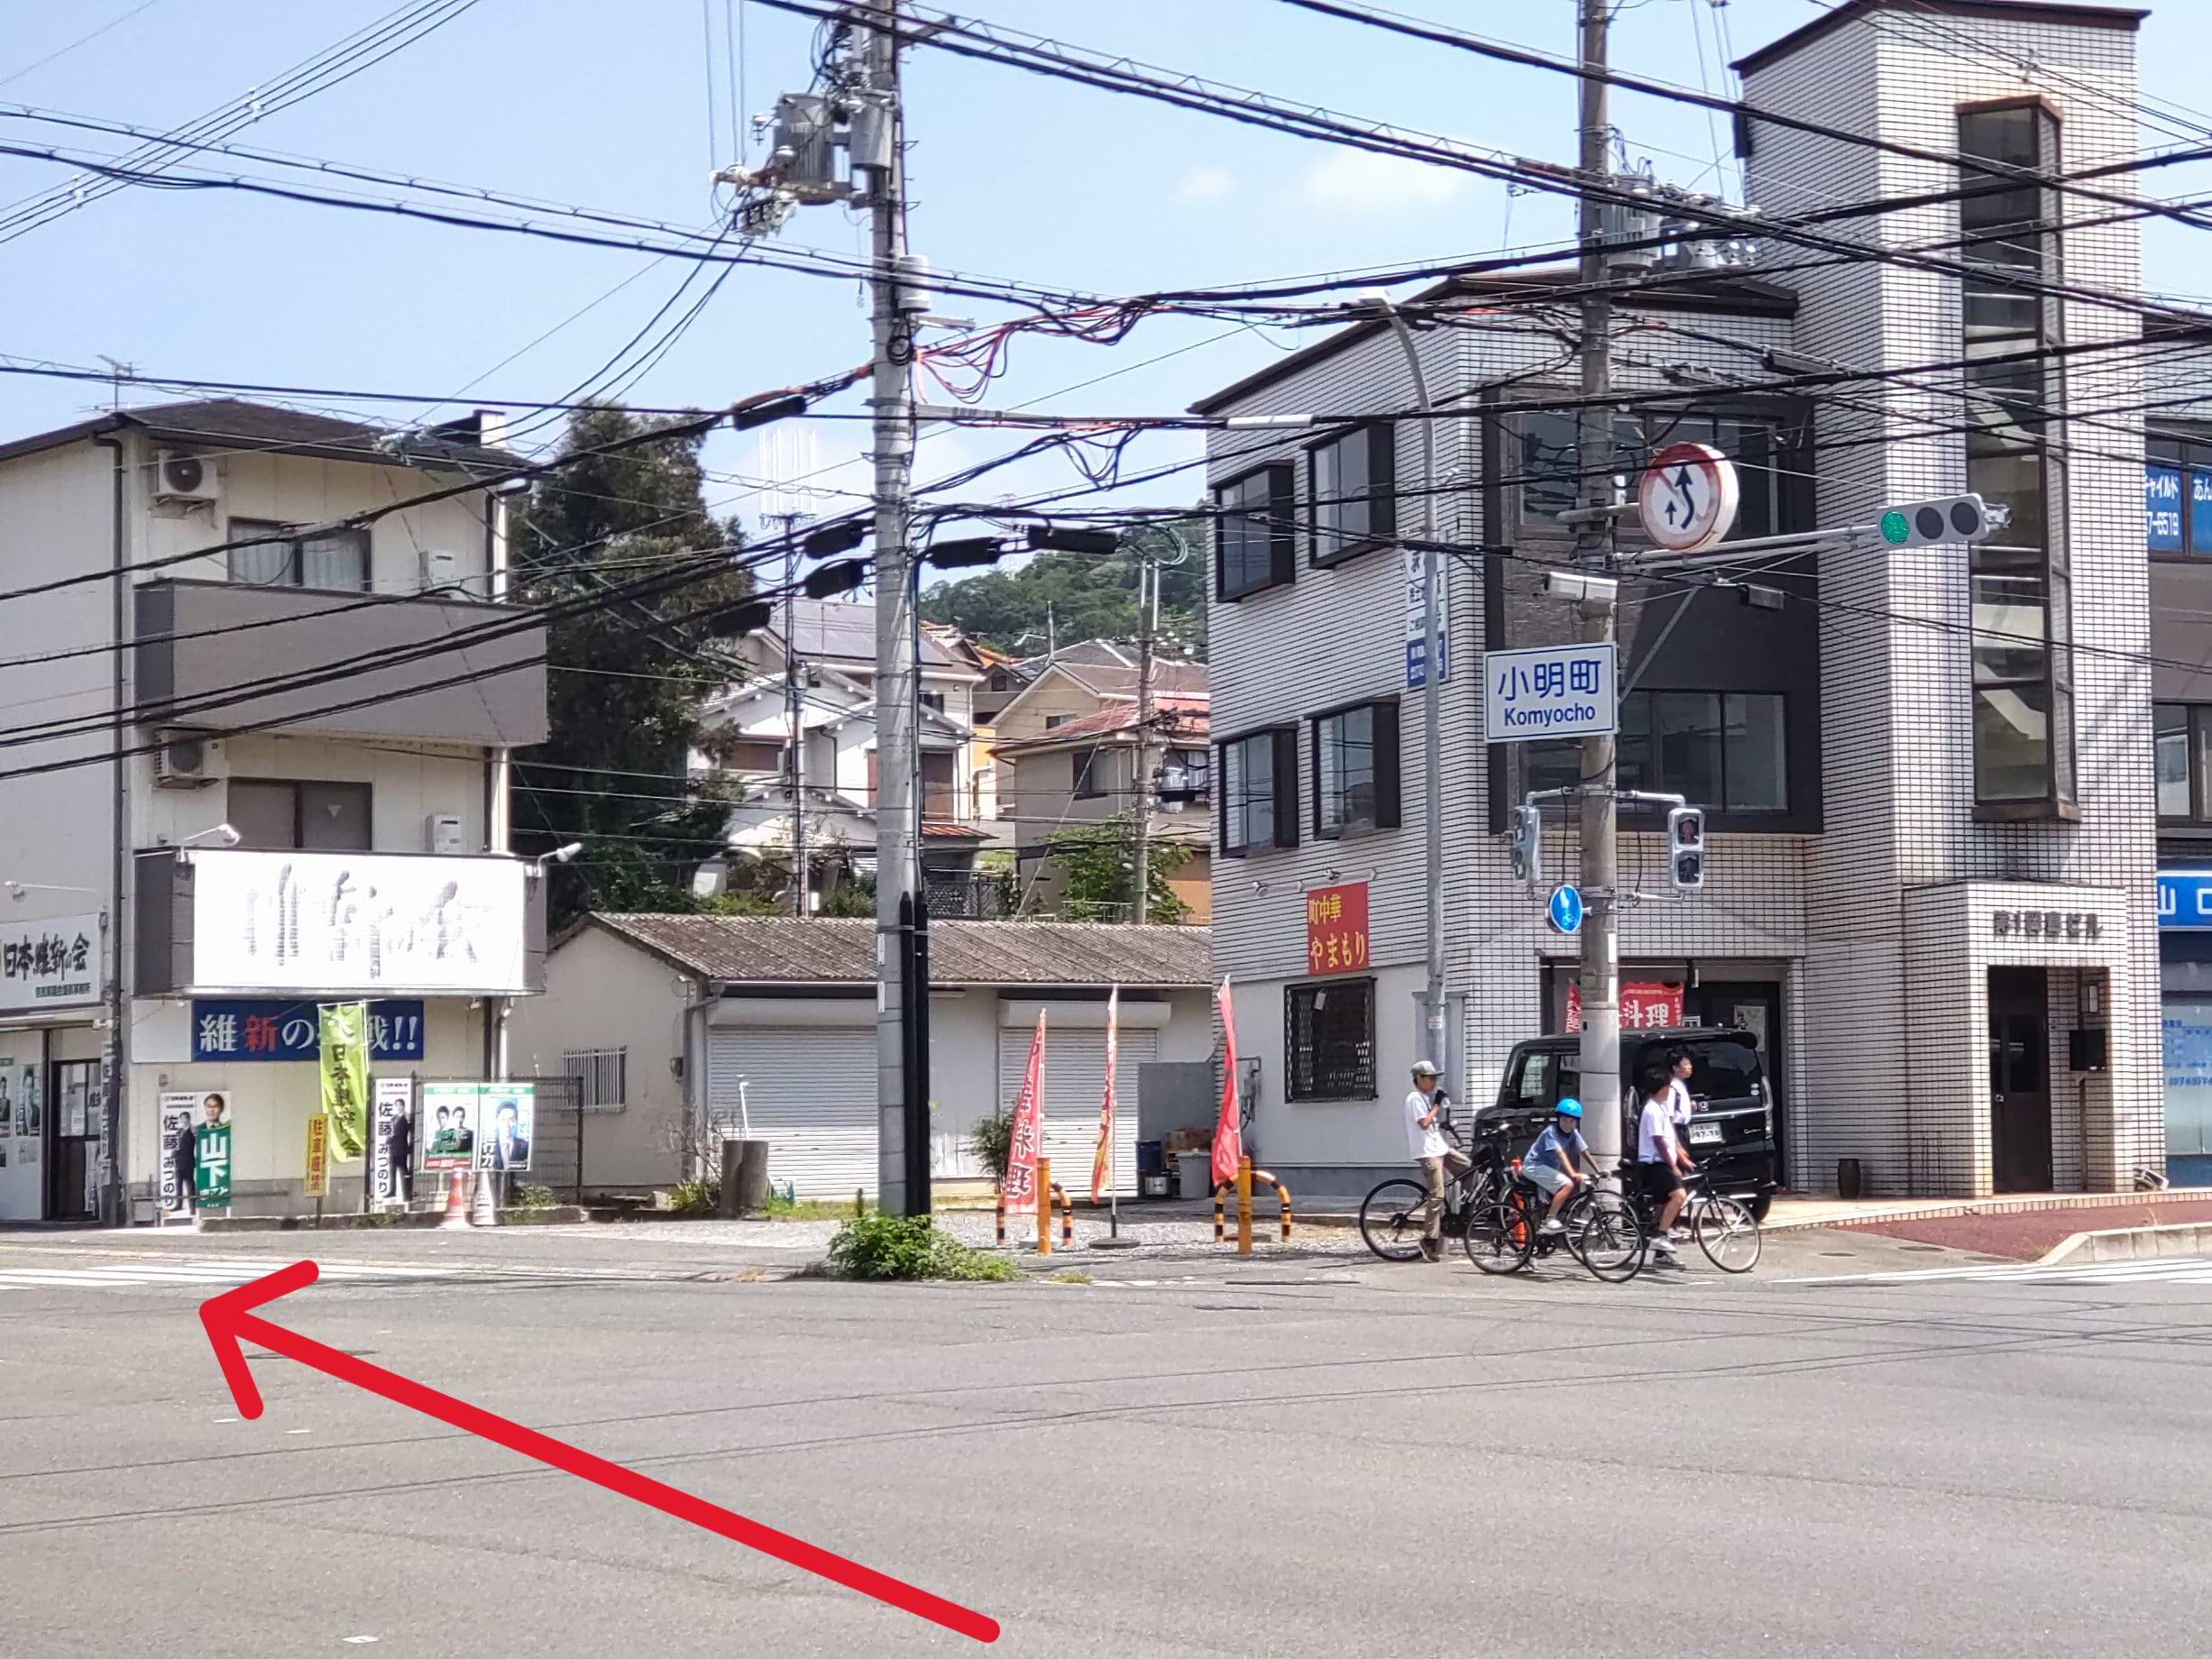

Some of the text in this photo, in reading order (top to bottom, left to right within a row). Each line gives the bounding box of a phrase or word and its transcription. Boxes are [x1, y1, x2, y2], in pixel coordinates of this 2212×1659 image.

[1498, 659, 1602, 701] 小明町
[1504, 702, 1596, 728] Komyocho
[1308, 894, 1341, 925] 町中華
[1310, 931, 1364, 970] やまもり
[199, 1013, 418, 1052] 維新の戦!!
[199, 1132, 229, 1187] 山下
